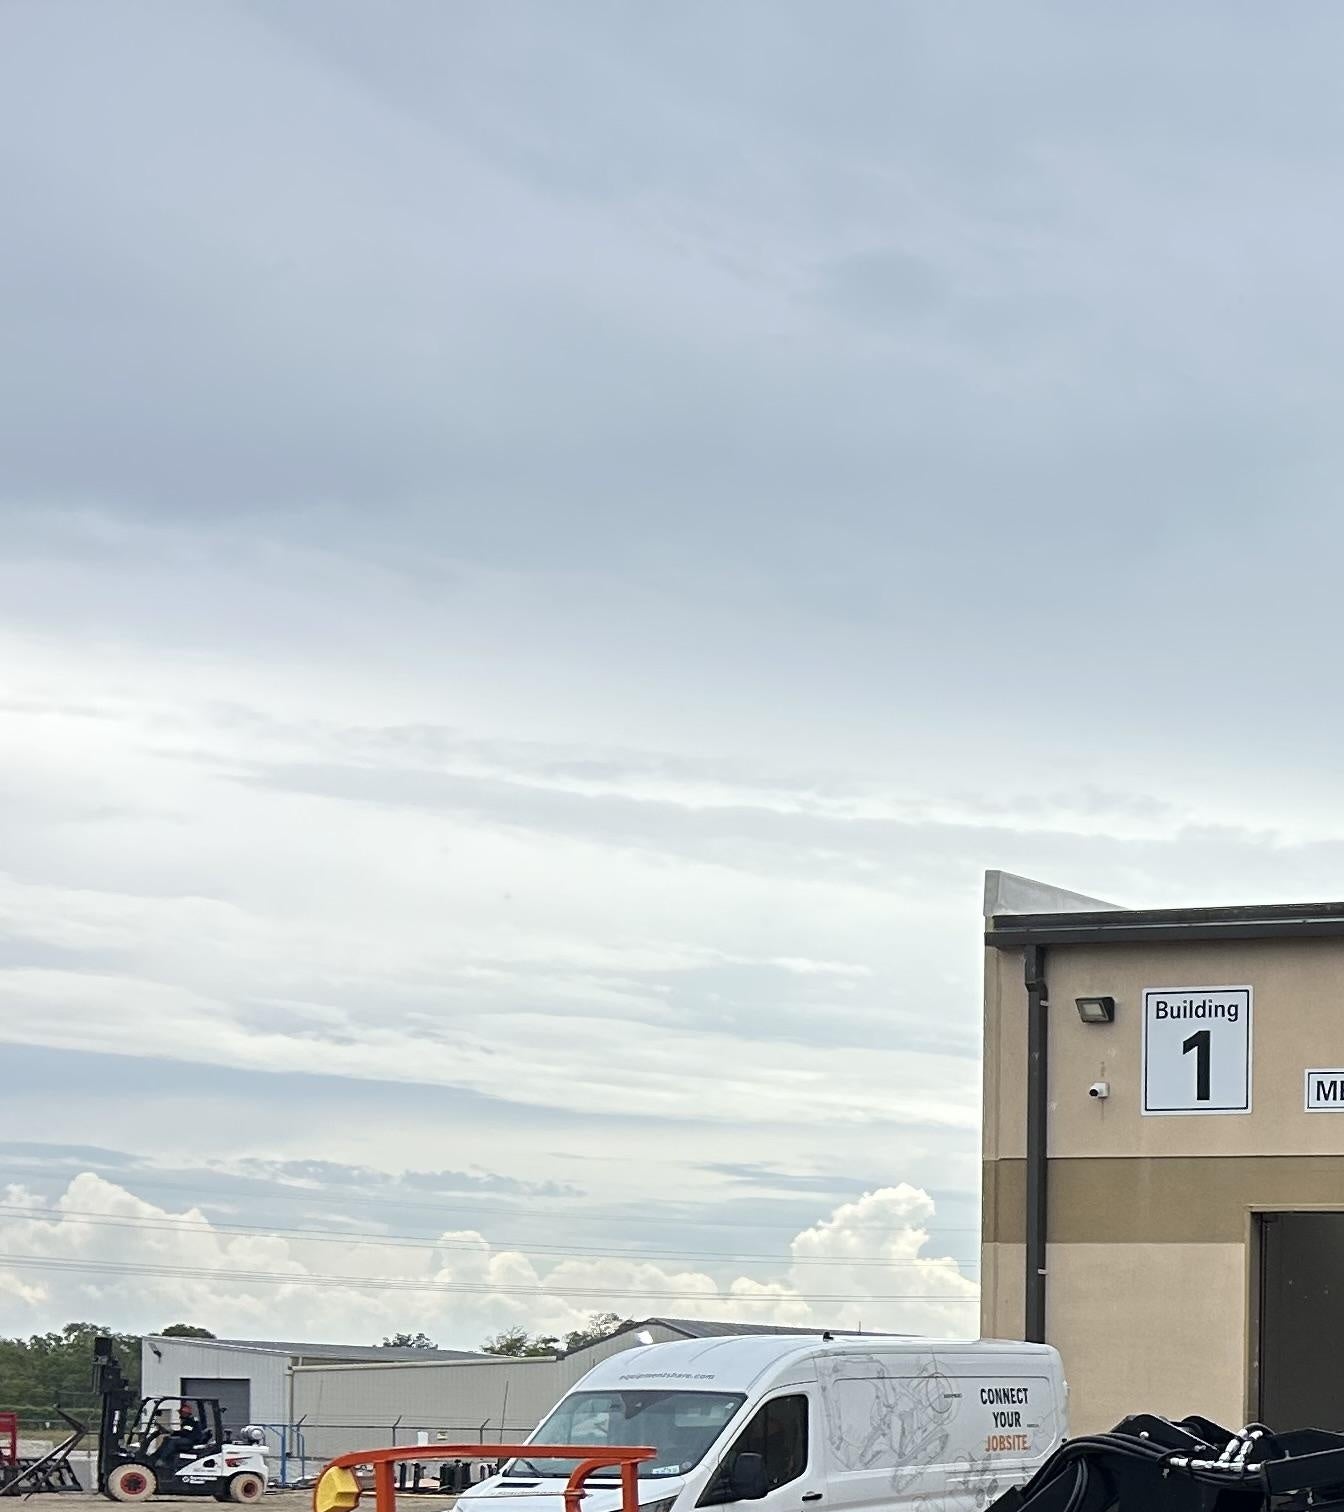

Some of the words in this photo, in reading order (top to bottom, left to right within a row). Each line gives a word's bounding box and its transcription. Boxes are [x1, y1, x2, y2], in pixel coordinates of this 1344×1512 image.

[1155, 999, 1239, 1023] Building
[1181, 1029, 1212, 1102] 1
[980, 1387, 1029, 1405] CONNECT
[992, 1411, 1022, 1429] YOUR
